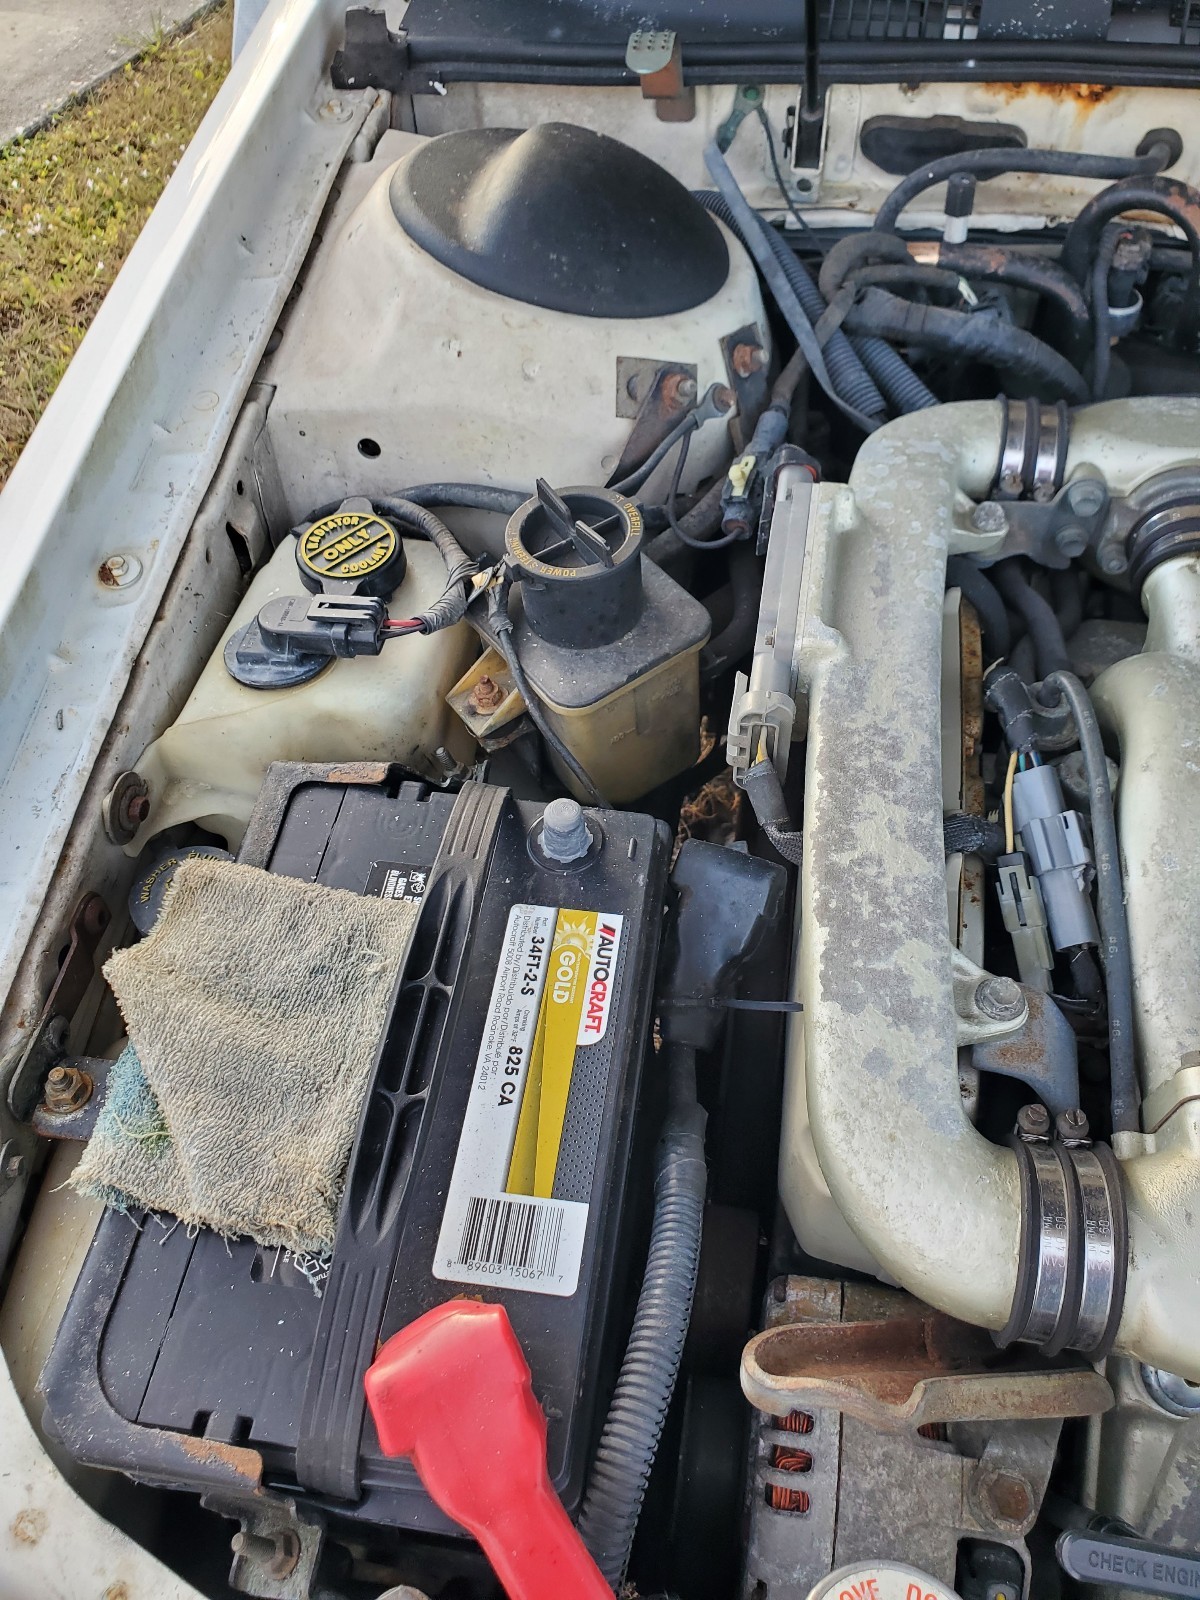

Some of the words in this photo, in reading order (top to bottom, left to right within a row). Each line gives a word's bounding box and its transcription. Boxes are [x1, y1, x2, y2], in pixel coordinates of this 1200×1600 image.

[306, 516, 360, 550] RADIATOR
[623, 502, 640, 537] OVERFILL
[323, 528, 370, 561] ONLY
[340, 541, 389, 574] COOLANT
[508, 537, 539, 569] STEERING
[540, 567, 577, 577] POWER
[140, 858, 178, 904] WASHER
[521, 936, 544, 997] 34FT-2-S
[553, 951, 575, 1004] GOLD
[586, 936, 613, 1033] AUTOCRAFT
[482, 1052, 492, 1064] VA
[504, 1046, 523, 1077] 825
[477, 1065, 489, 1090] 24012
[497, 1080, 515, 1108] CA
[467, 1261, 502, 1275] 89603
[509, 1266, 543, 1280] 15067
[557, 1275, 563, 1283] 7
[1088, 1550, 1148, 1578] CHECK
